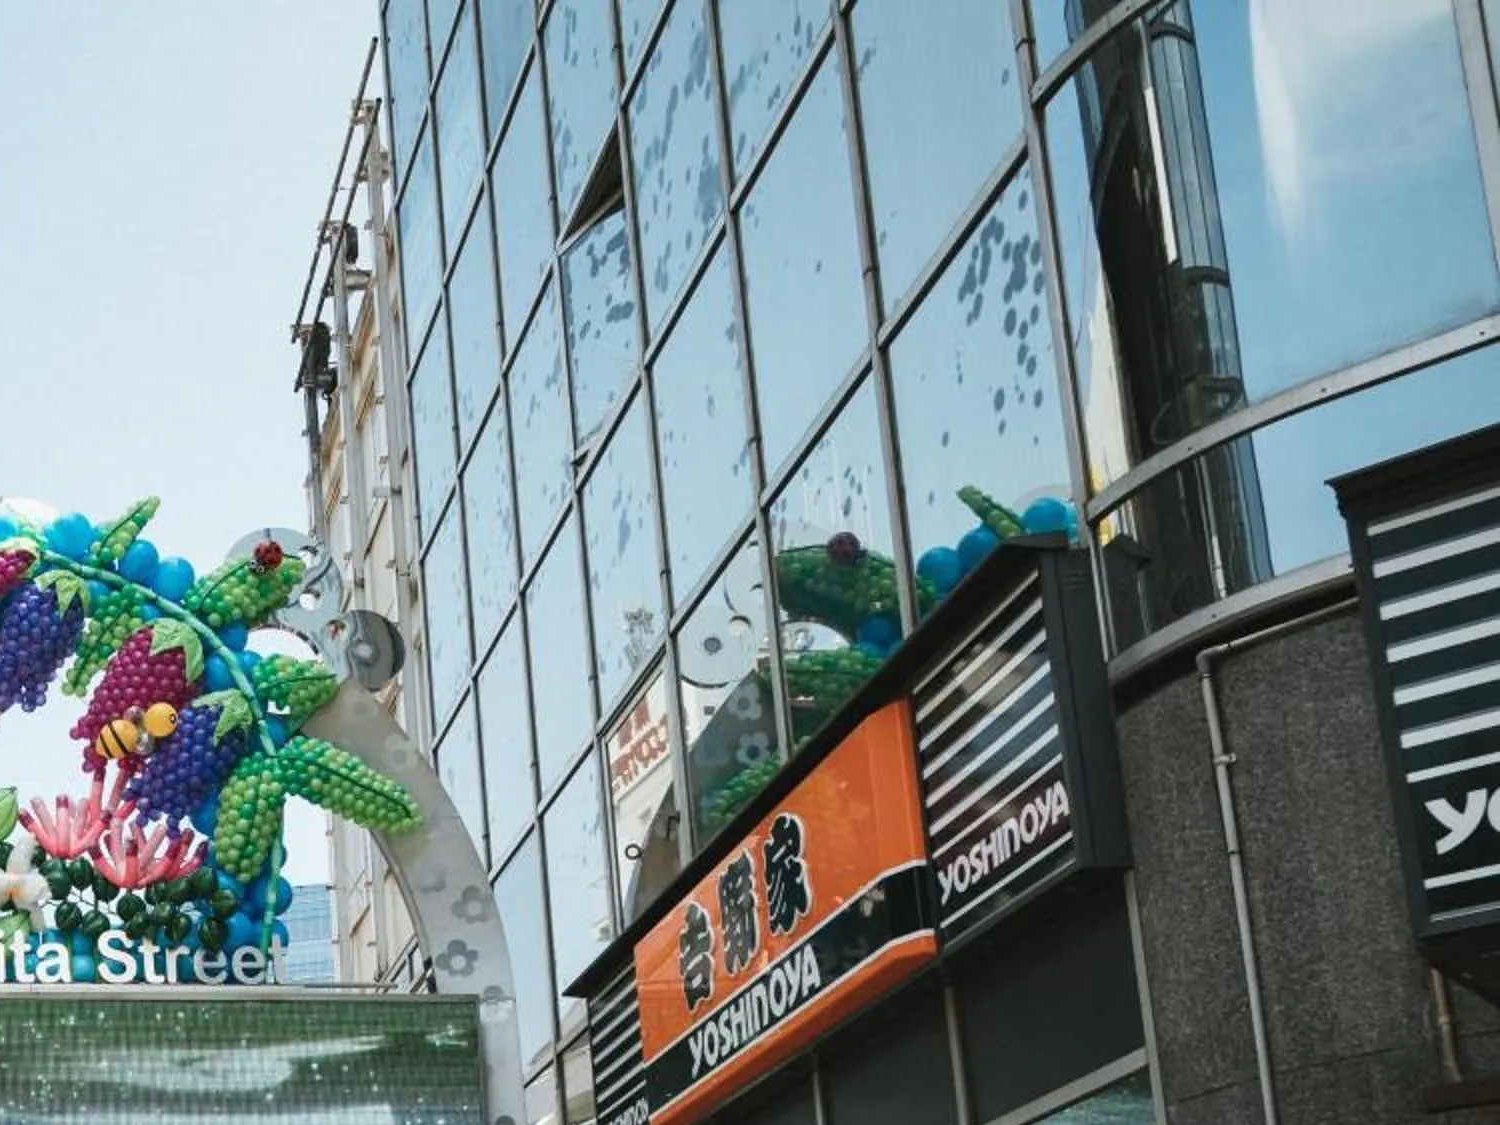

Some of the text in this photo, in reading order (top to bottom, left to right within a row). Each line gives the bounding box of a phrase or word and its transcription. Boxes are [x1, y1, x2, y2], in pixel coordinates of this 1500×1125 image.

[935, 780, 1070, 904] YOSHINOYA
[97, 929, 289, 986] Street
[677, 811, 813, 1013] 吉野家
[687, 942, 823, 1078] YOSHINOYA
